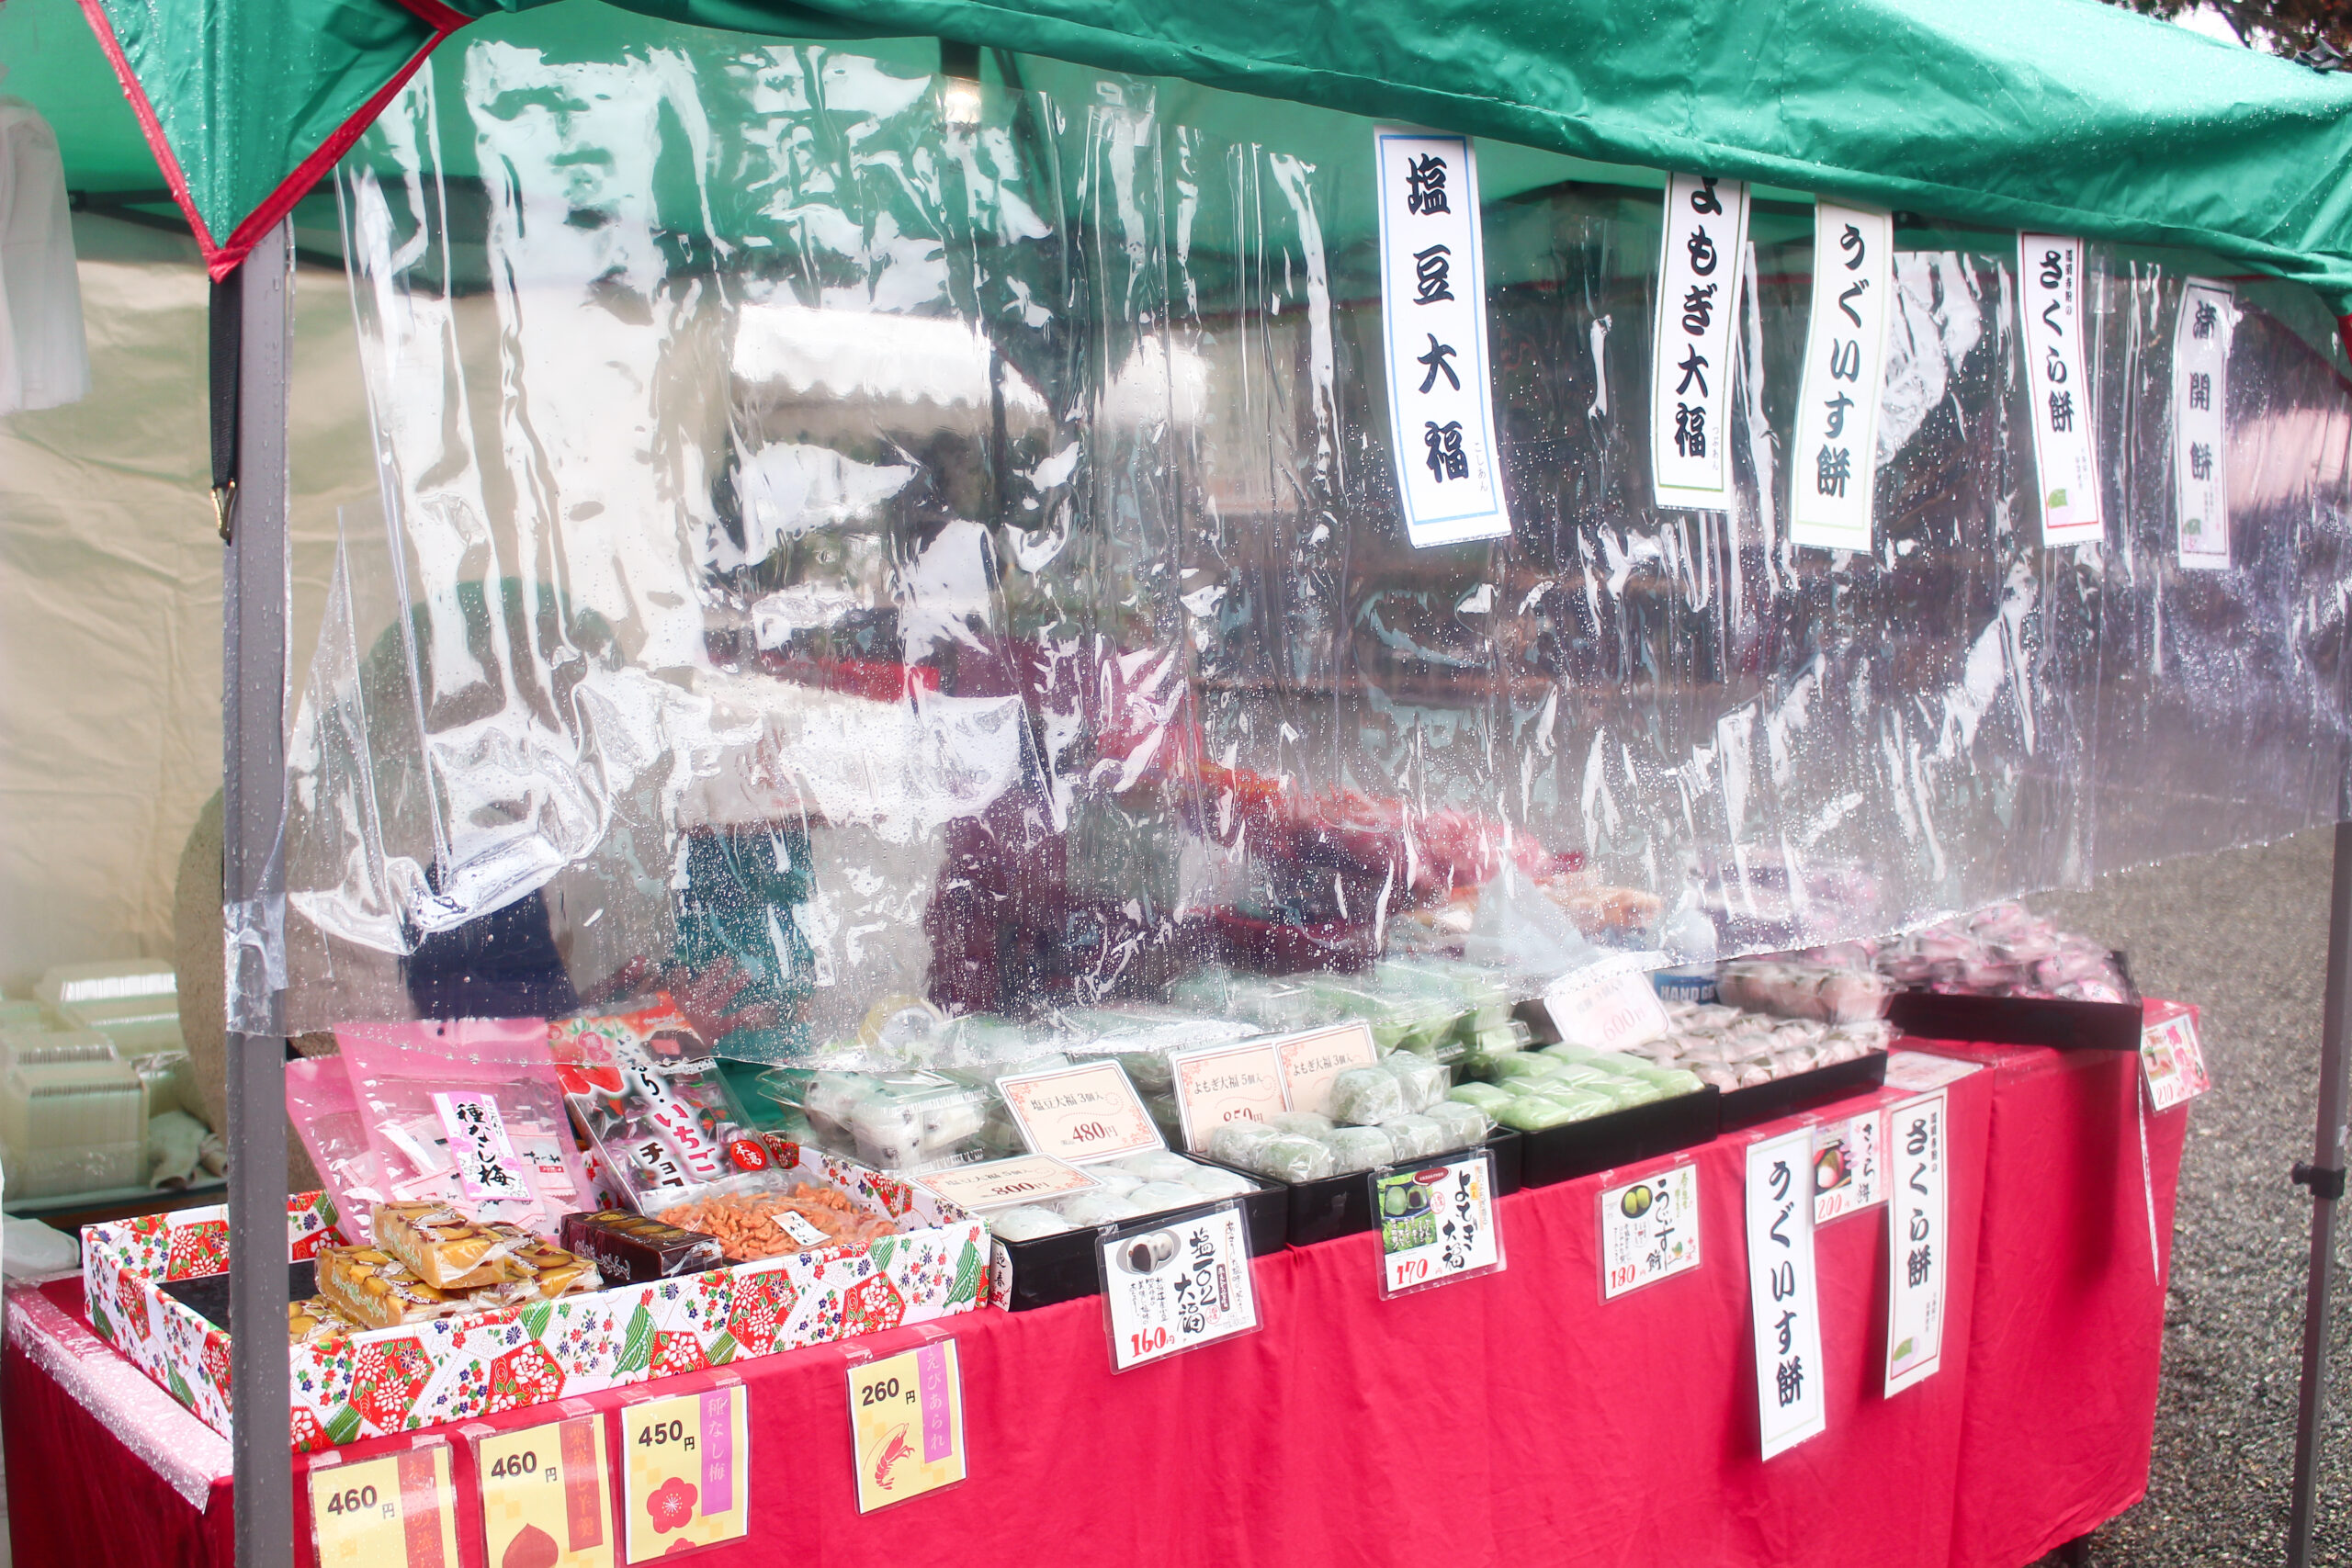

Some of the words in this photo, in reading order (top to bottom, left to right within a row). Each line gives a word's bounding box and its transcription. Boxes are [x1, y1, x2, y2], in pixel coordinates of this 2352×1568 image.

[1406, 152, 1469, 483] 塩豆大福
[1675, 175, 1722, 458] よもぎ大福
[2040, 250, 2075, 434] さくら餅
[1816, 222, 1870, 498] うぐいす餅
[1660, 986, 1699, 1001] HAND
[1193, 1076, 1240, 1095] よもぎ大福
[1293, 1056, 1332, 1076] よもぎ大福
[1031, 1095, 1078, 1111] 塩豆大福
[1072, 1122, 1118, 1143] 480円
[457, 1103, 515, 1187] 種なし梅
[1905, 1118, 1931, 1290] さくら餅
[1768, 1160, 1804, 1408] うぐいす餅
[862, 1378, 916, 1406] 260円
[926, 1358, 945, 1451] えびあられ
[639, 1419, 695, 1451] 450円
[707, 1396, 726, 1483] 種なし梅
[492, 1450, 558, 1483] 460円
[327, 1485, 395, 1519] 460円
